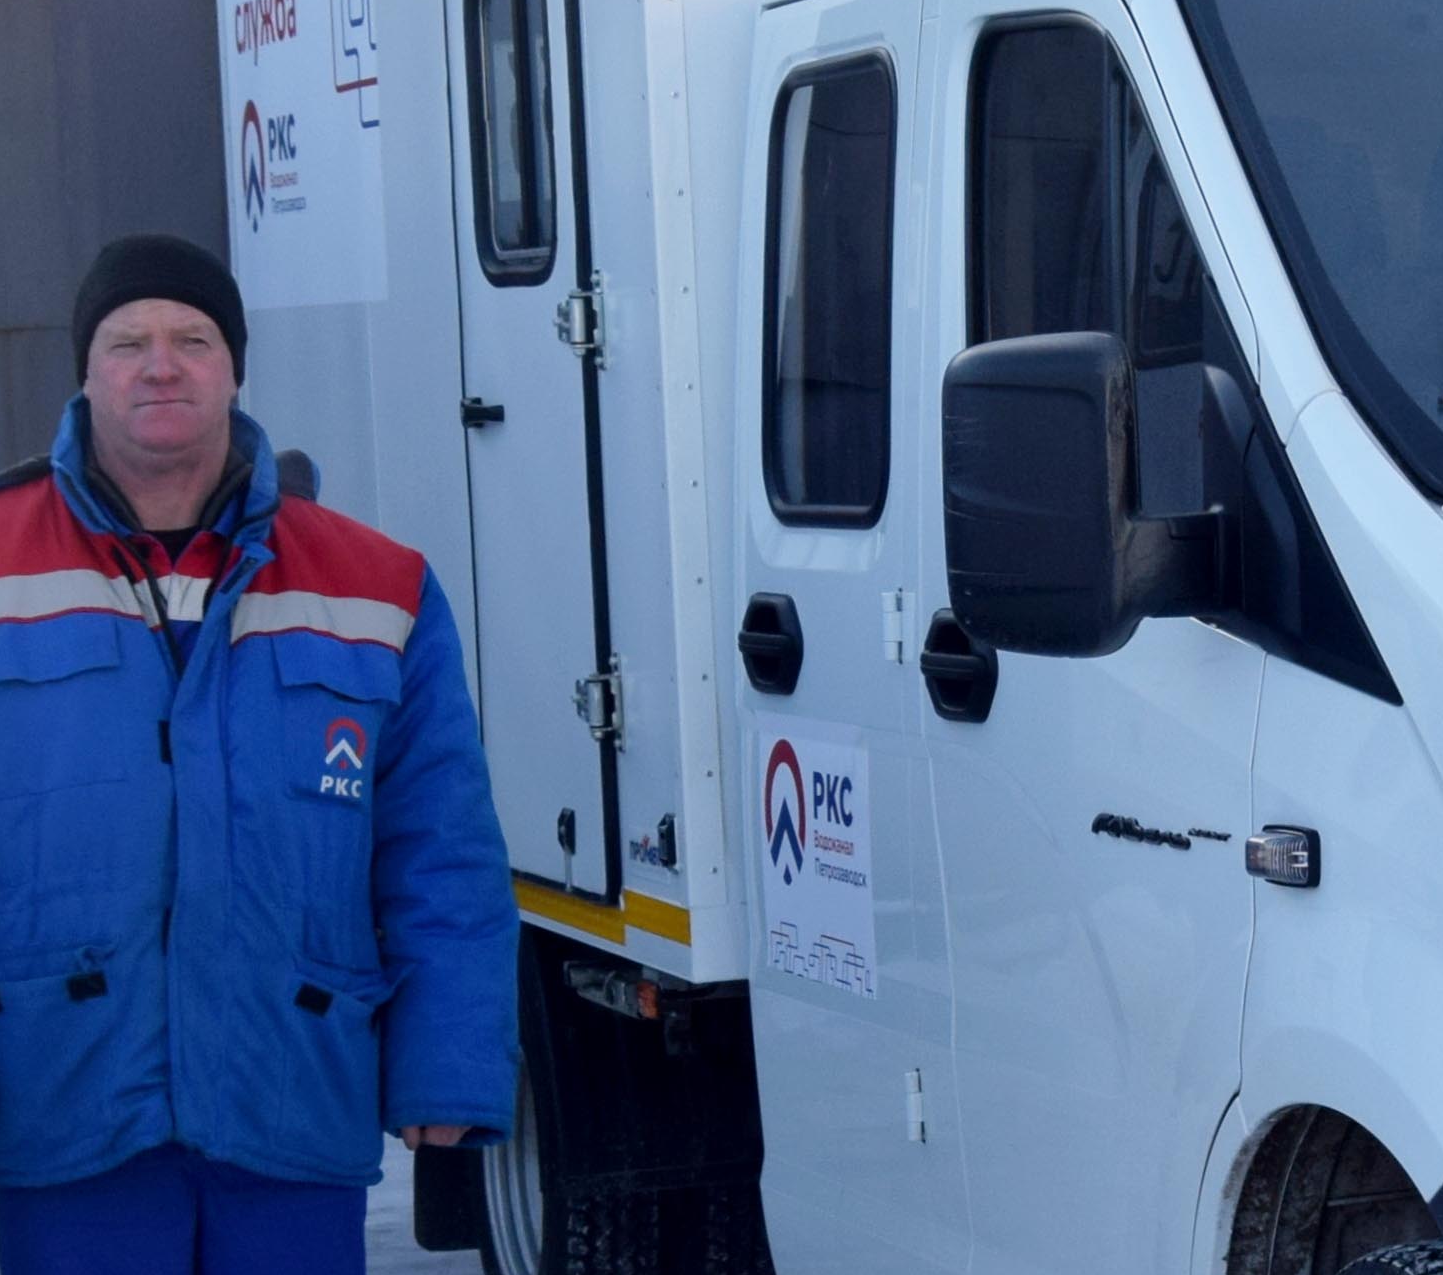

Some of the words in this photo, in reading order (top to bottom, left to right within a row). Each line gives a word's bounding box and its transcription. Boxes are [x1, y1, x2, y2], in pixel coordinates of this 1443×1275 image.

[268, 113, 296, 162] РКС
[319, 775, 363, 798] РКС
[813, 771, 853, 827] РКС
